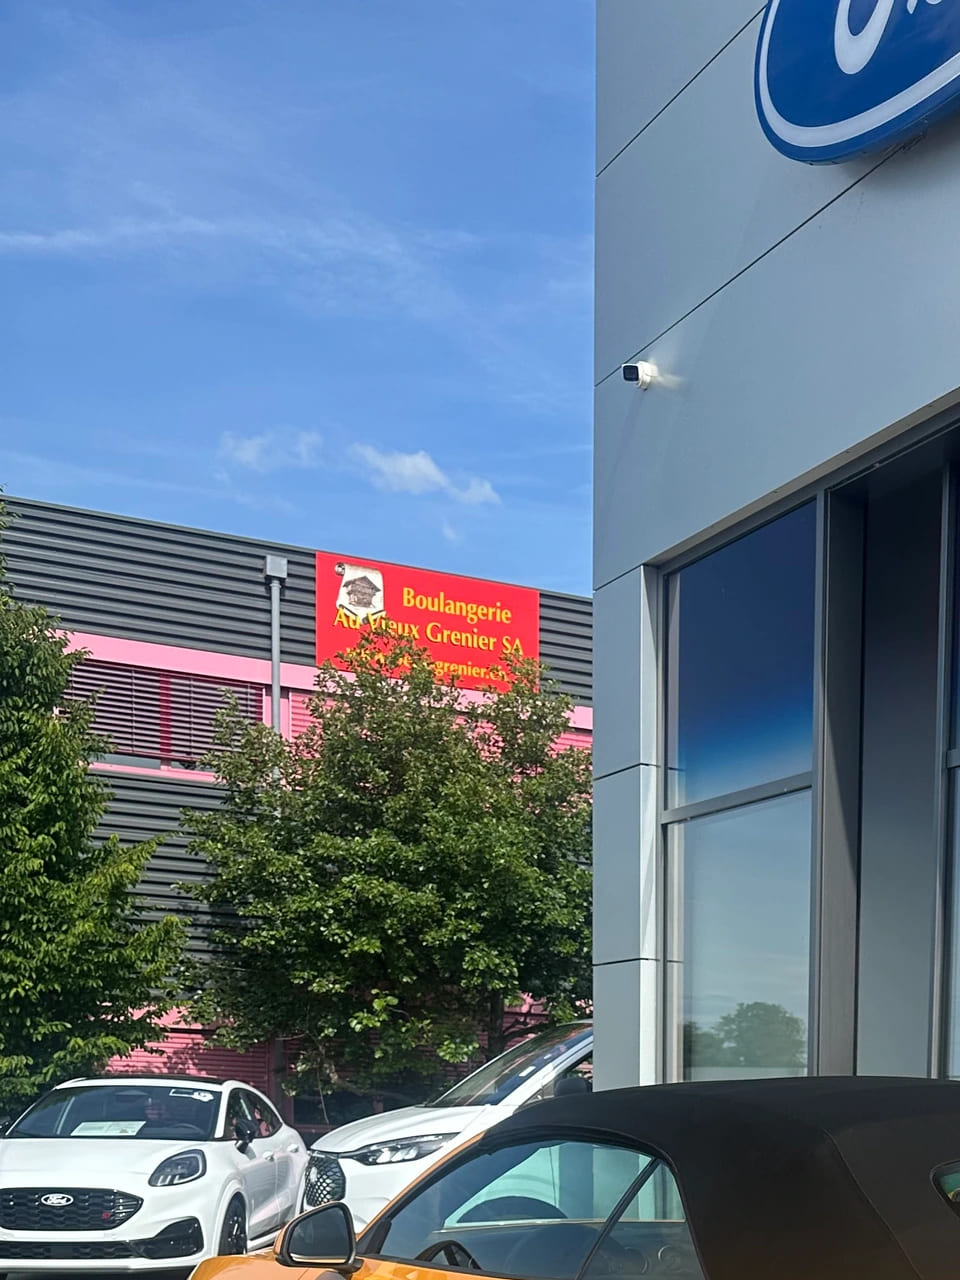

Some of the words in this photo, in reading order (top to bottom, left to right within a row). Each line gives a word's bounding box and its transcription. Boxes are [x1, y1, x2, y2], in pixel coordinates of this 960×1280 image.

[402, 587, 513, 625] Boulangerie
[333, 607, 361, 630] Au
[367, 611, 420, 640] Vieux
[425, 622, 497, 651] Grenier
[502, 635, 525, 656] SA
